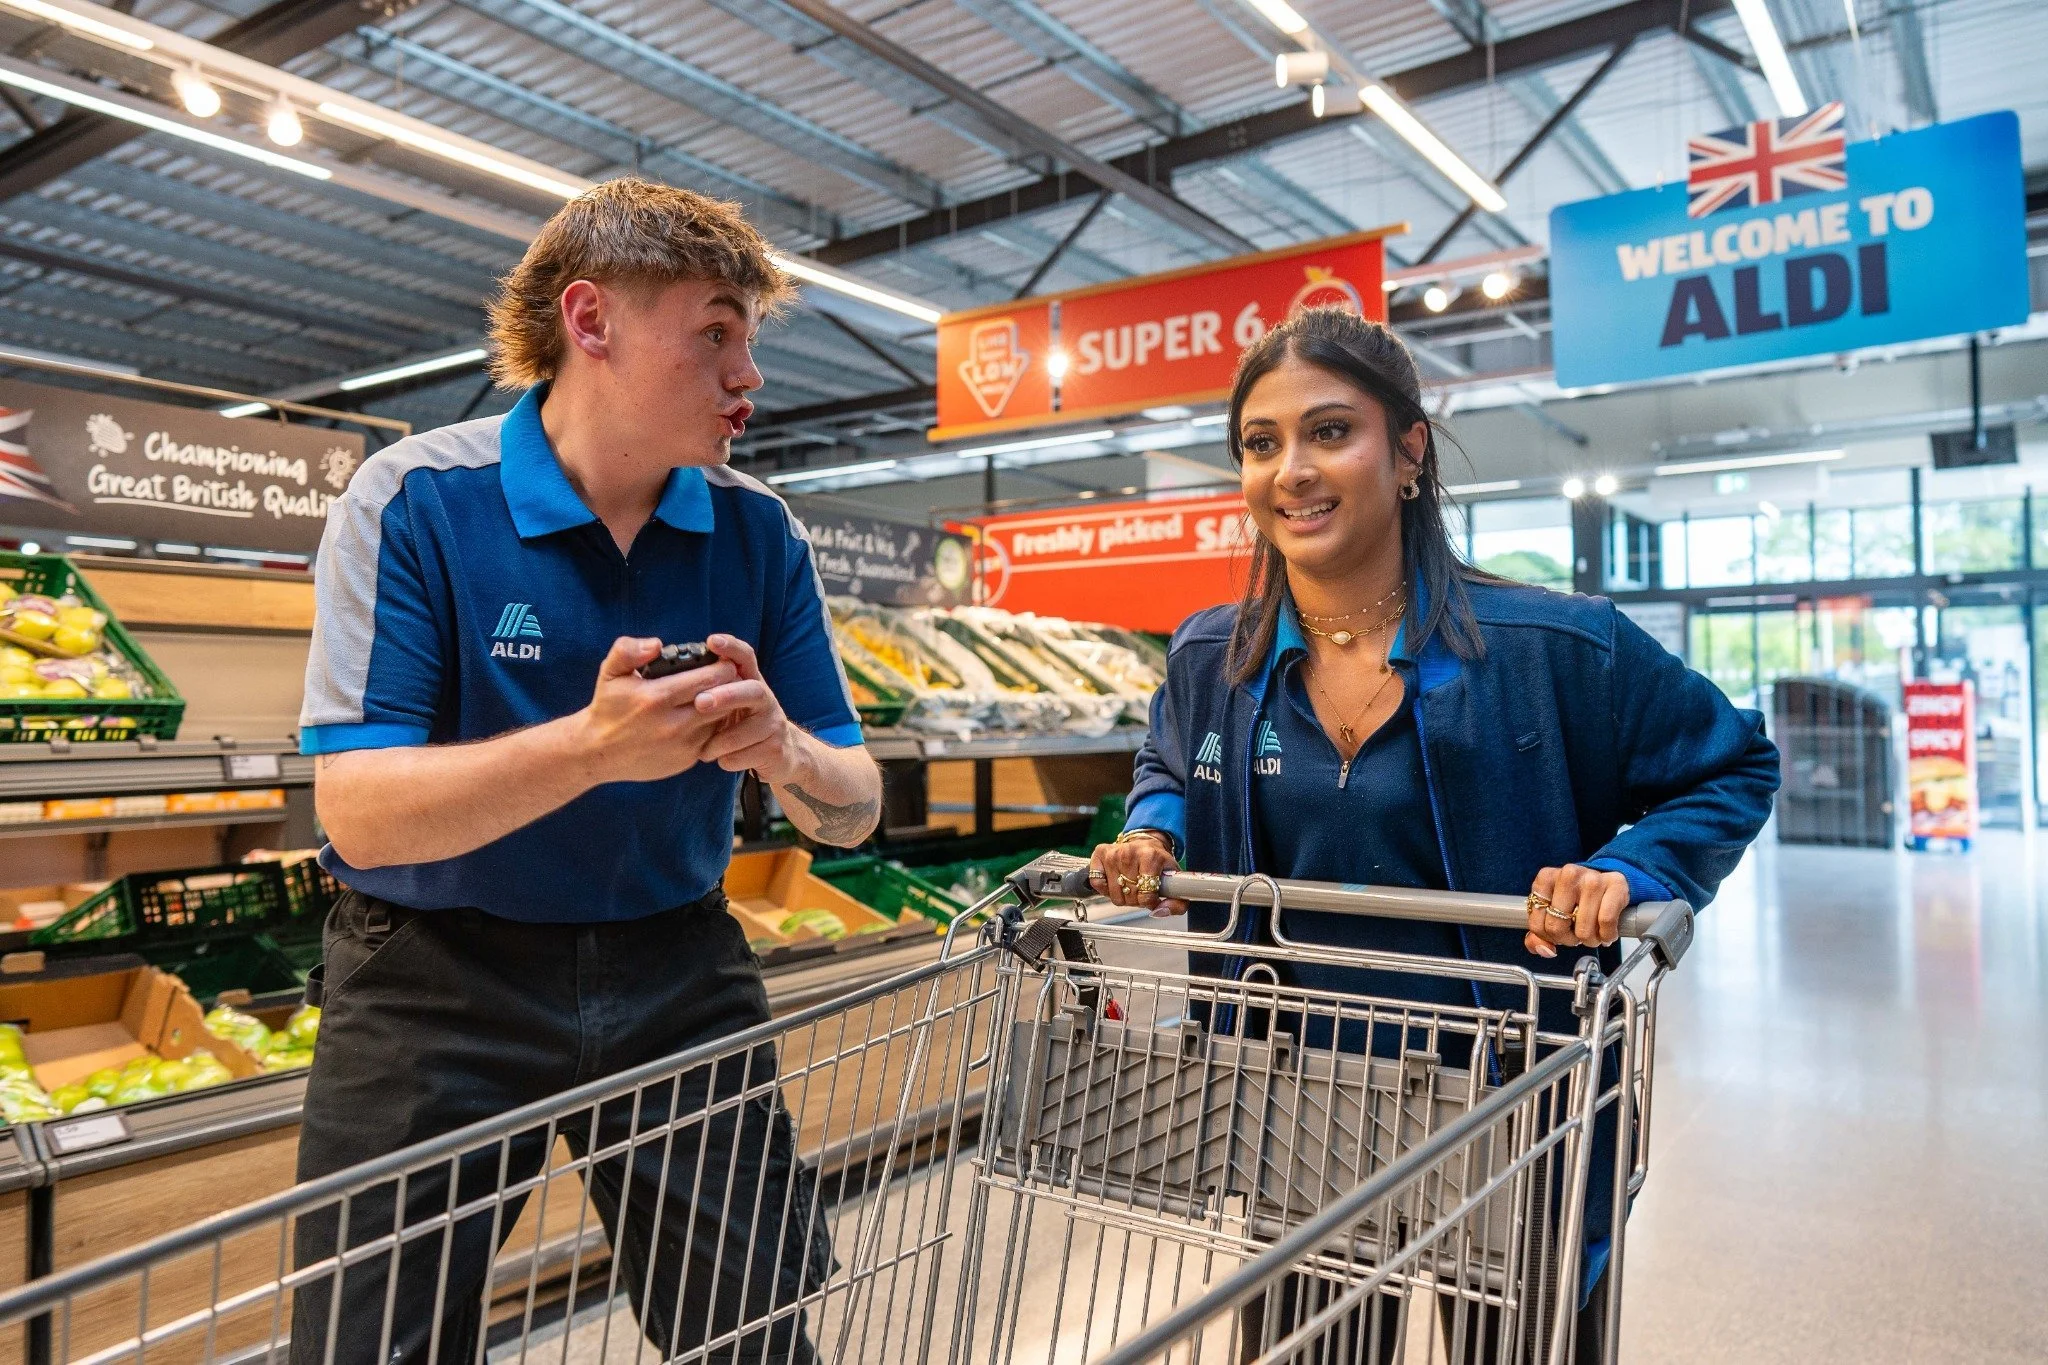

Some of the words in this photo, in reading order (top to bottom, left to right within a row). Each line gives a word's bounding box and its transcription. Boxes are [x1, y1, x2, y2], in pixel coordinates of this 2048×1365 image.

[1617, 202, 1850, 281] WELCOME
[1860, 186, 1934, 237] TO
[1659, 242, 1890, 349] ALDI
[1078, 310, 1222, 375] SUPER
[1233, 301, 1266, 348] 6
[144, 431, 308, 486] Championing
[88, 464, 167, 501] Great
[172, 474, 258, 510] British
[263, 484, 337, 519] Quali
[1012, 524, 1096, 557] Freshly
[1099, 512, 1184, 554] picked
[490, 641, 541, 661] ALDI
[1193, 764, 1221, 784] ALD
